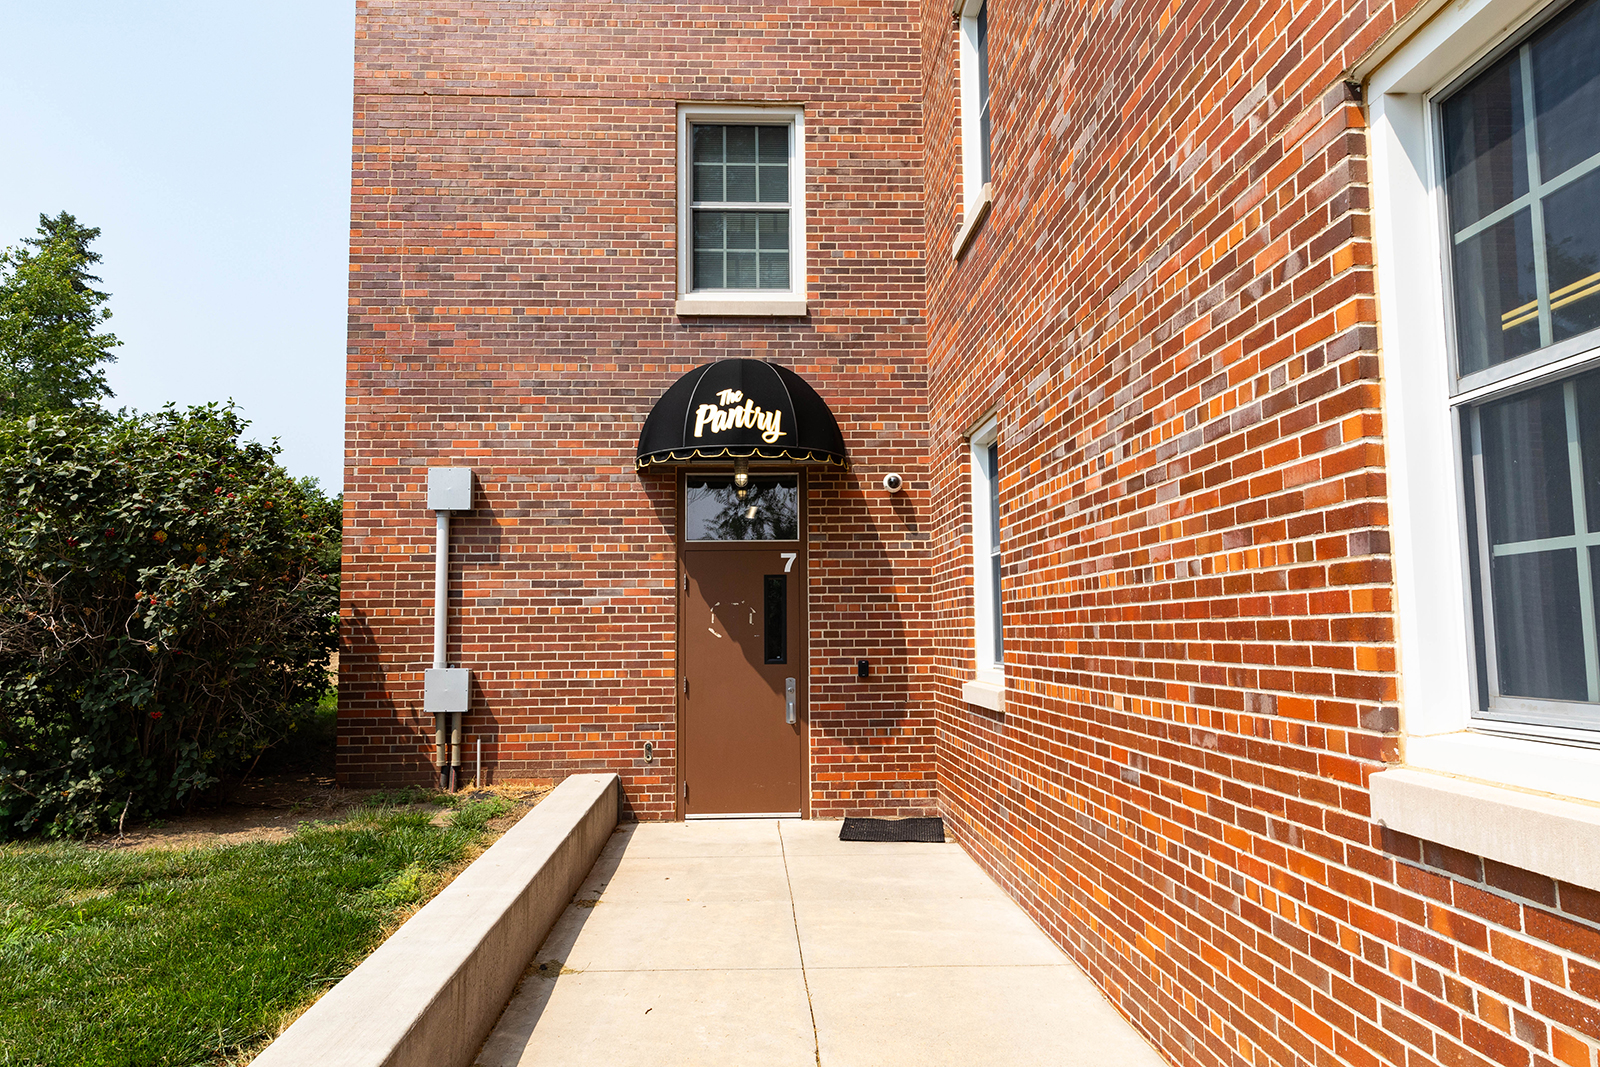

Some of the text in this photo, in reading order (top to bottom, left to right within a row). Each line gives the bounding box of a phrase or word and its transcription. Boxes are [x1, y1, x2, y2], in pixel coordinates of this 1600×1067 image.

[716, 388, 744, 407] The
[693, 398, 787, 444] Pantry
[780, 552, 797, 573] 7
